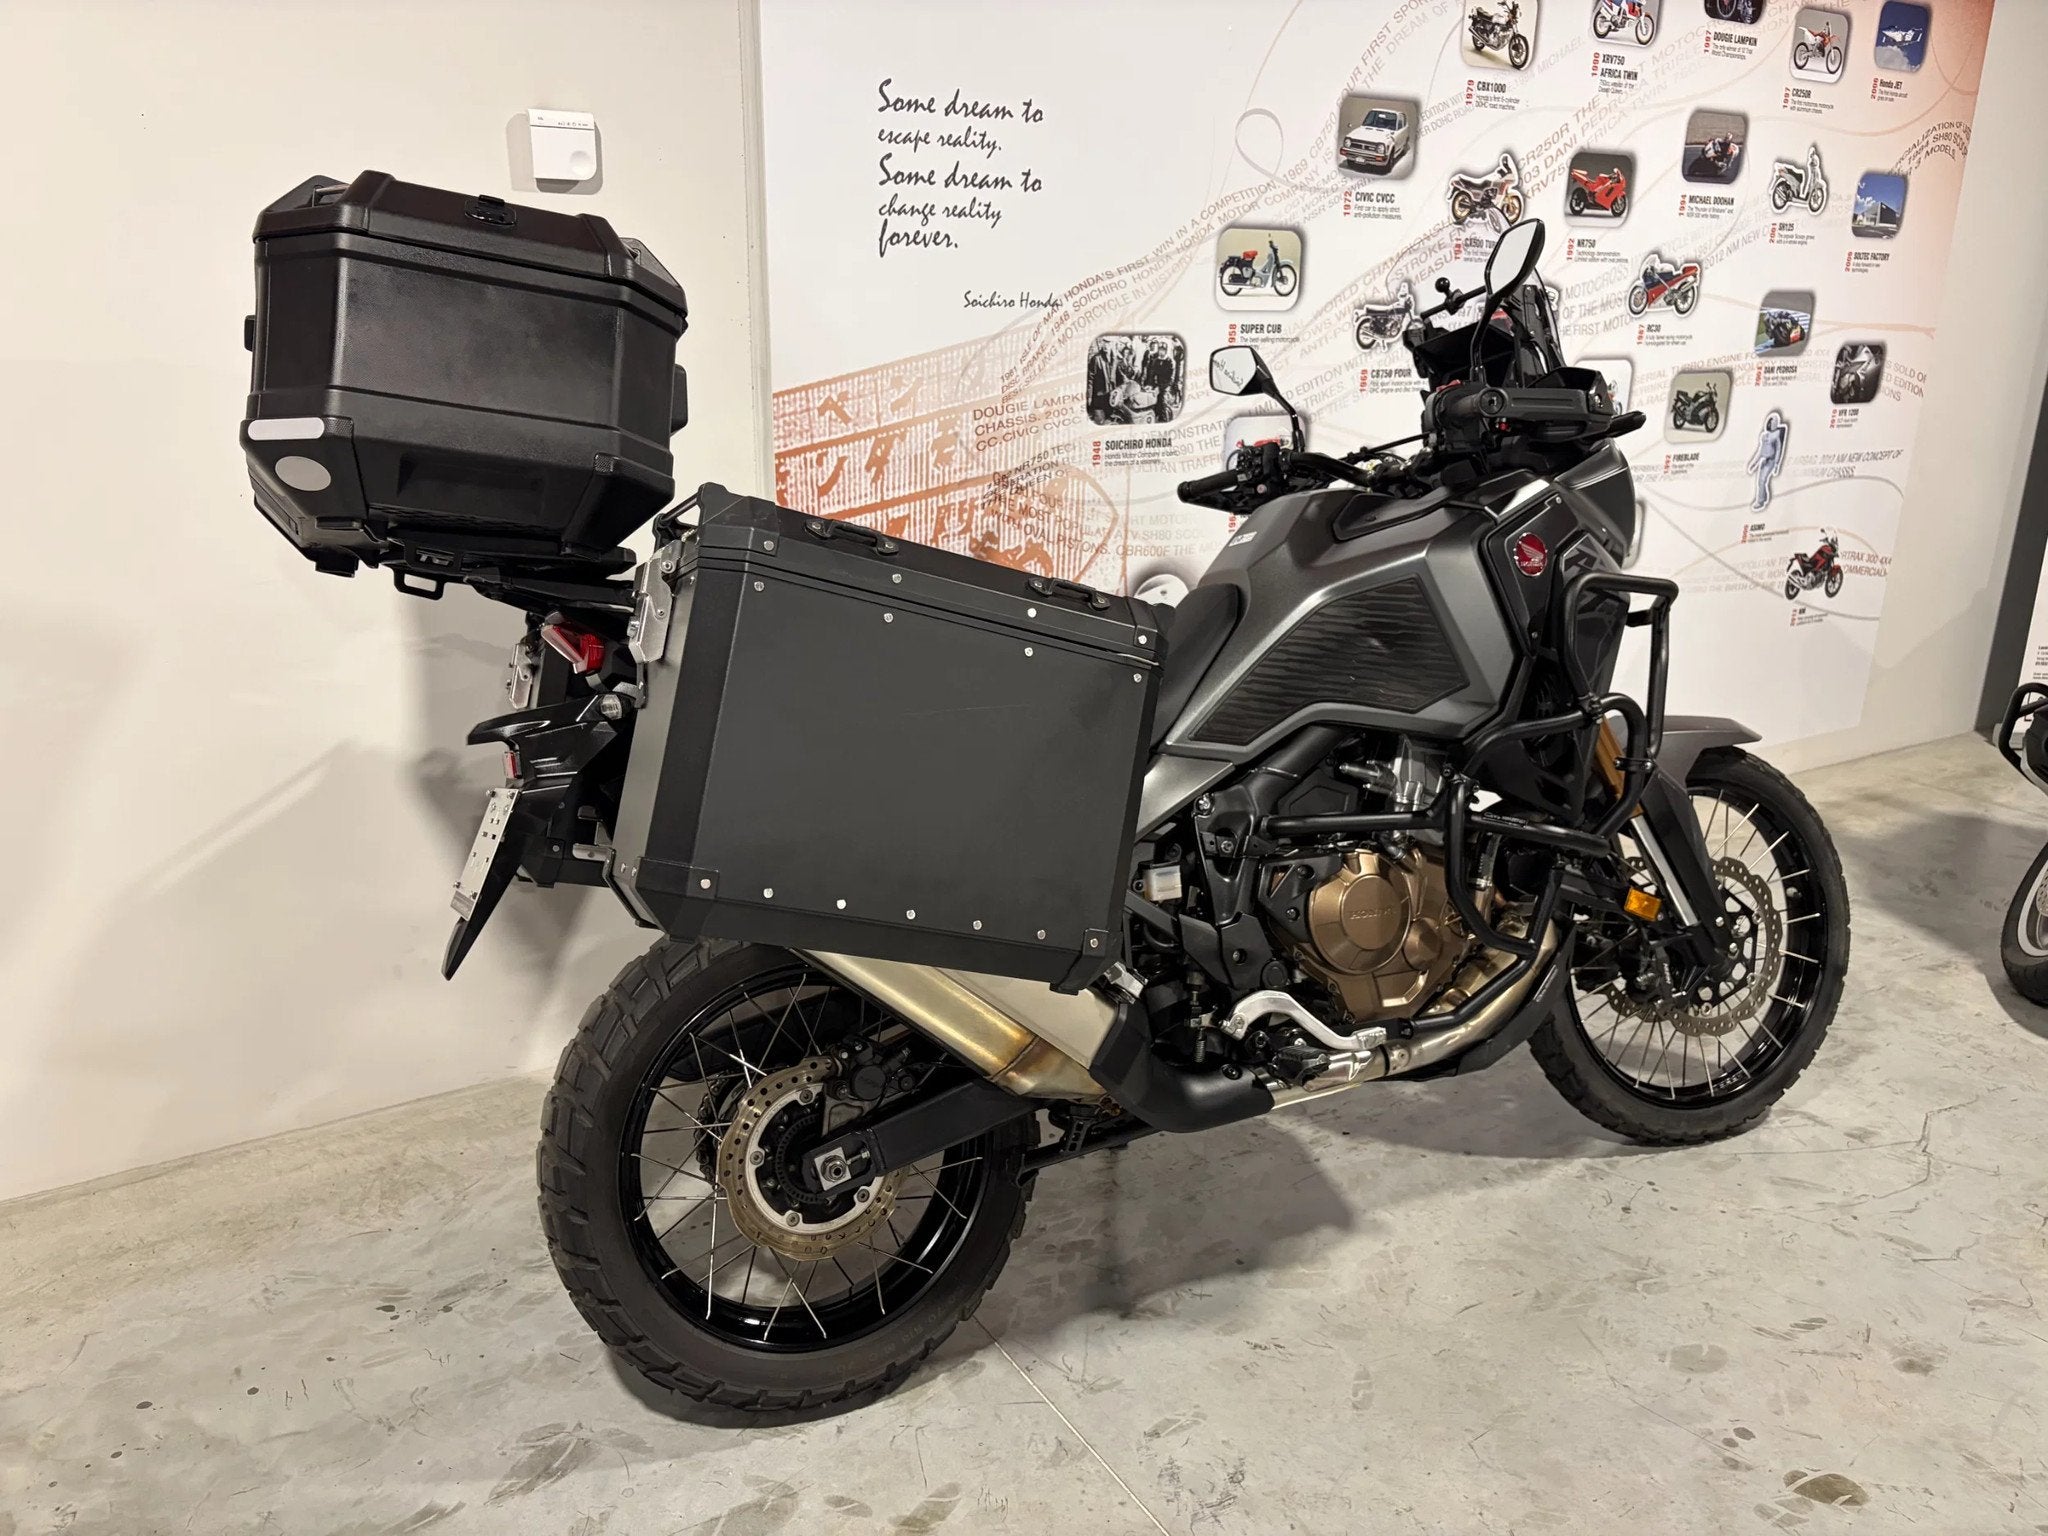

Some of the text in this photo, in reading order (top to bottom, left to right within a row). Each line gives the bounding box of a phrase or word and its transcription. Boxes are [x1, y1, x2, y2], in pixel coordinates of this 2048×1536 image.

[1713, 31, 1758, 47] DOUGIE LAMPKIN
[1591, 51, 1600, 77] 1990
[1601, 53, 1625, 66] XRV750
[1476, 80, 1506, 94] CBX1000
[1600, 67, 1638, 81] AFRICA TWIN
[878, 78, 1043, 123] Some dream to
[1420, 99, 1450, 121] EDITION
[1572, 94, 1601, 124] THE
[878, 126, 1002, 159] escape reality.
[1544, 135, 1578, 169] DANI
[879, 152, 1042, 192] Some dream to
[1064, 270, 1115, 301] HONDA'S
[1116, 255, 1151, 276] FIRST
[1152, 236, 1175, 257] WIN
[1175, 225, 1188, 240] IN
[1190, 216, 1200, 229] A
[1282, 158, 1310, 184] 1969
[1361, 21, 1392, 66] FIRST
[1072, 279, 1127, 313] SOICHIRO
[1132, 254, 1173, 284] HONDA
[1176, 223, 1215, 254] HONDA
[1218, 201, 1262, 226] MOTOR
[1264, 168, 1320, 207] COMPANY
[1362, 57, 1387, 90] THE
[1388, 11, 1430, 55] DREAM
[1343, 190, 1353, 217] 1972
[1355, 191, 1395, 204] CIVIC CVCC
[1688, 195, 1711, 205] MICHAEL
[878, 193, 1002, 229] change reality
[878, 218, 958, 258] forever.
[964, 290, 1060, 309] Soichiro Honda
[1057, 294, 1131, 348] MOTORCYCLE
[1131, 286, 1145, 300] IN
[1240, 323, 1282, 334] SUPER CUB
[1228, 323, 1237, 347] 958
[973, 400, 1029, 421] DOUGIE
[974, 407, 1075, 437] CHASSIS. 2001
[1043, 416, 1081, 431] CVCC
[1092, 440, 1101, 467] 1948
[1105, 438, 1173, 451] SOICHIRO HONDA
